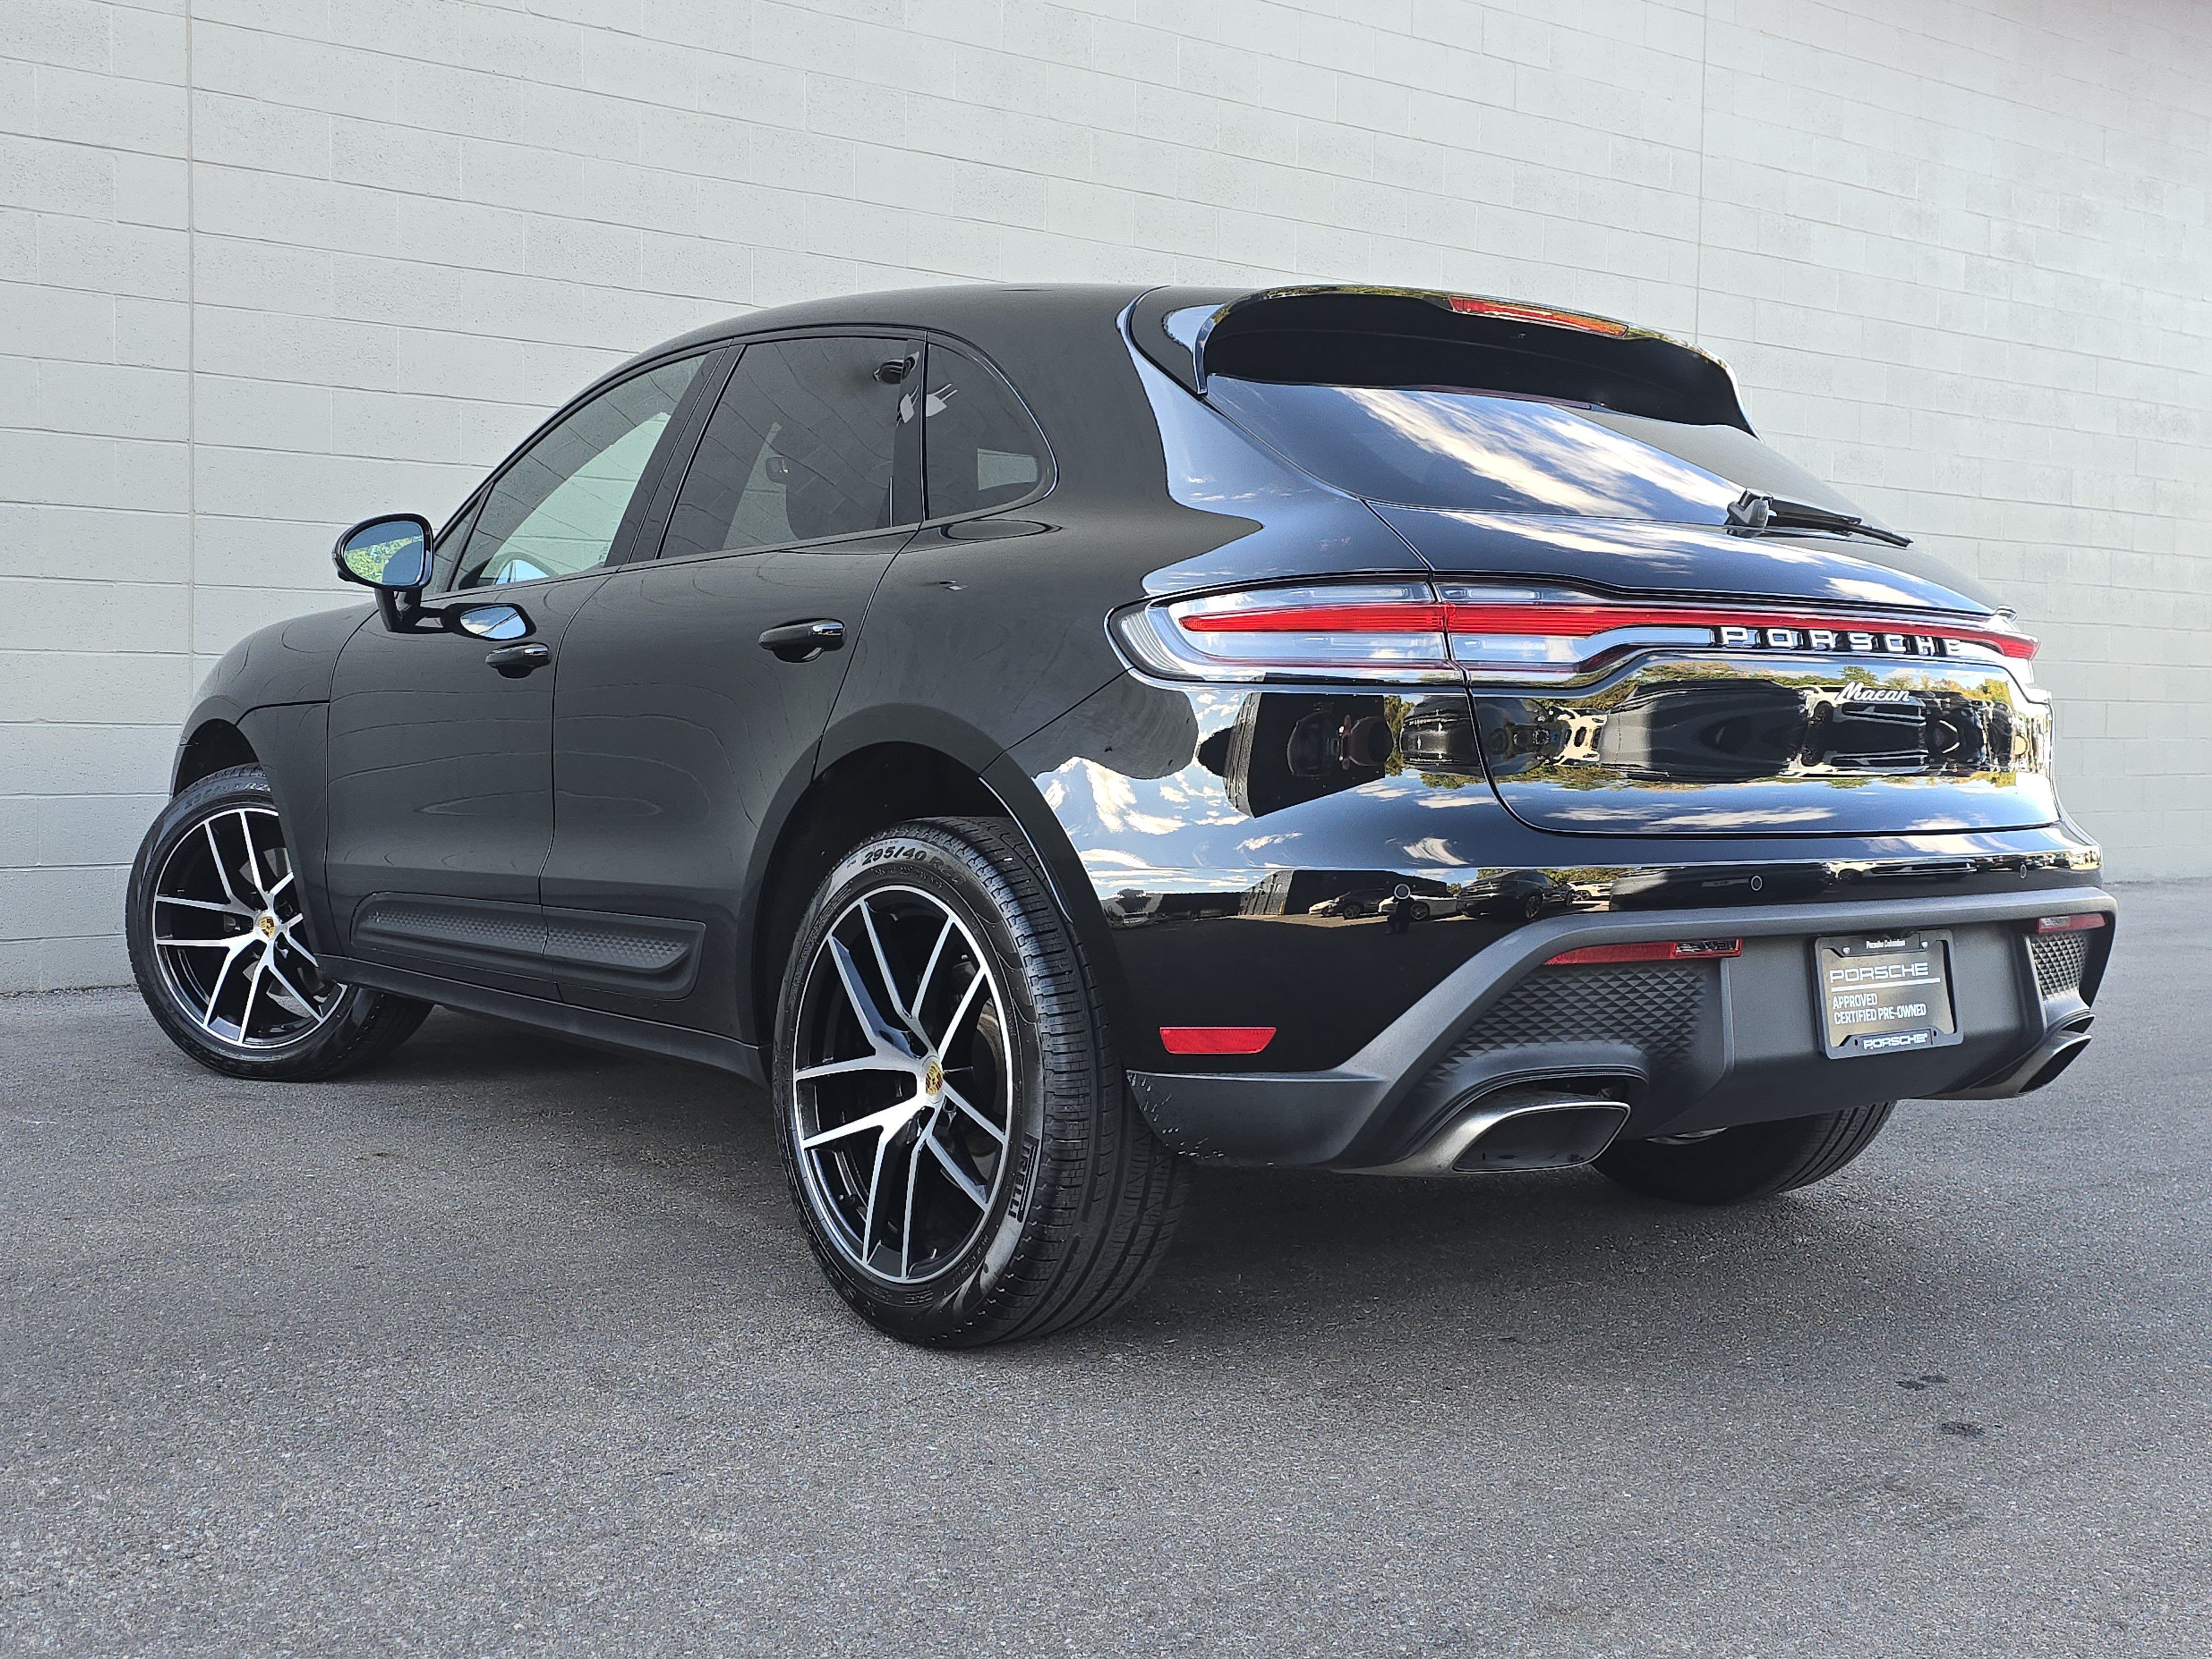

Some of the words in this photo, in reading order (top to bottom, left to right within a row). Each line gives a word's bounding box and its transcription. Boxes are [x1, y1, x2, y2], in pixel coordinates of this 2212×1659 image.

[1720, 627, 1961, 656] PORSCHE
[1835, 681, 1910, 702] Macan
[862, 846, 927, 866] 295/40
[1829, 962, 1929, 983] PORSCHE
[1833, 993, 1878, 1010] APPROVED
[1834, 1008, 1877, 1025] CERTIFIED
[1877, 1003, 1927, 1020] PRE-OWNED
[1863, 1032, 1928, 1050] PORSCHE
